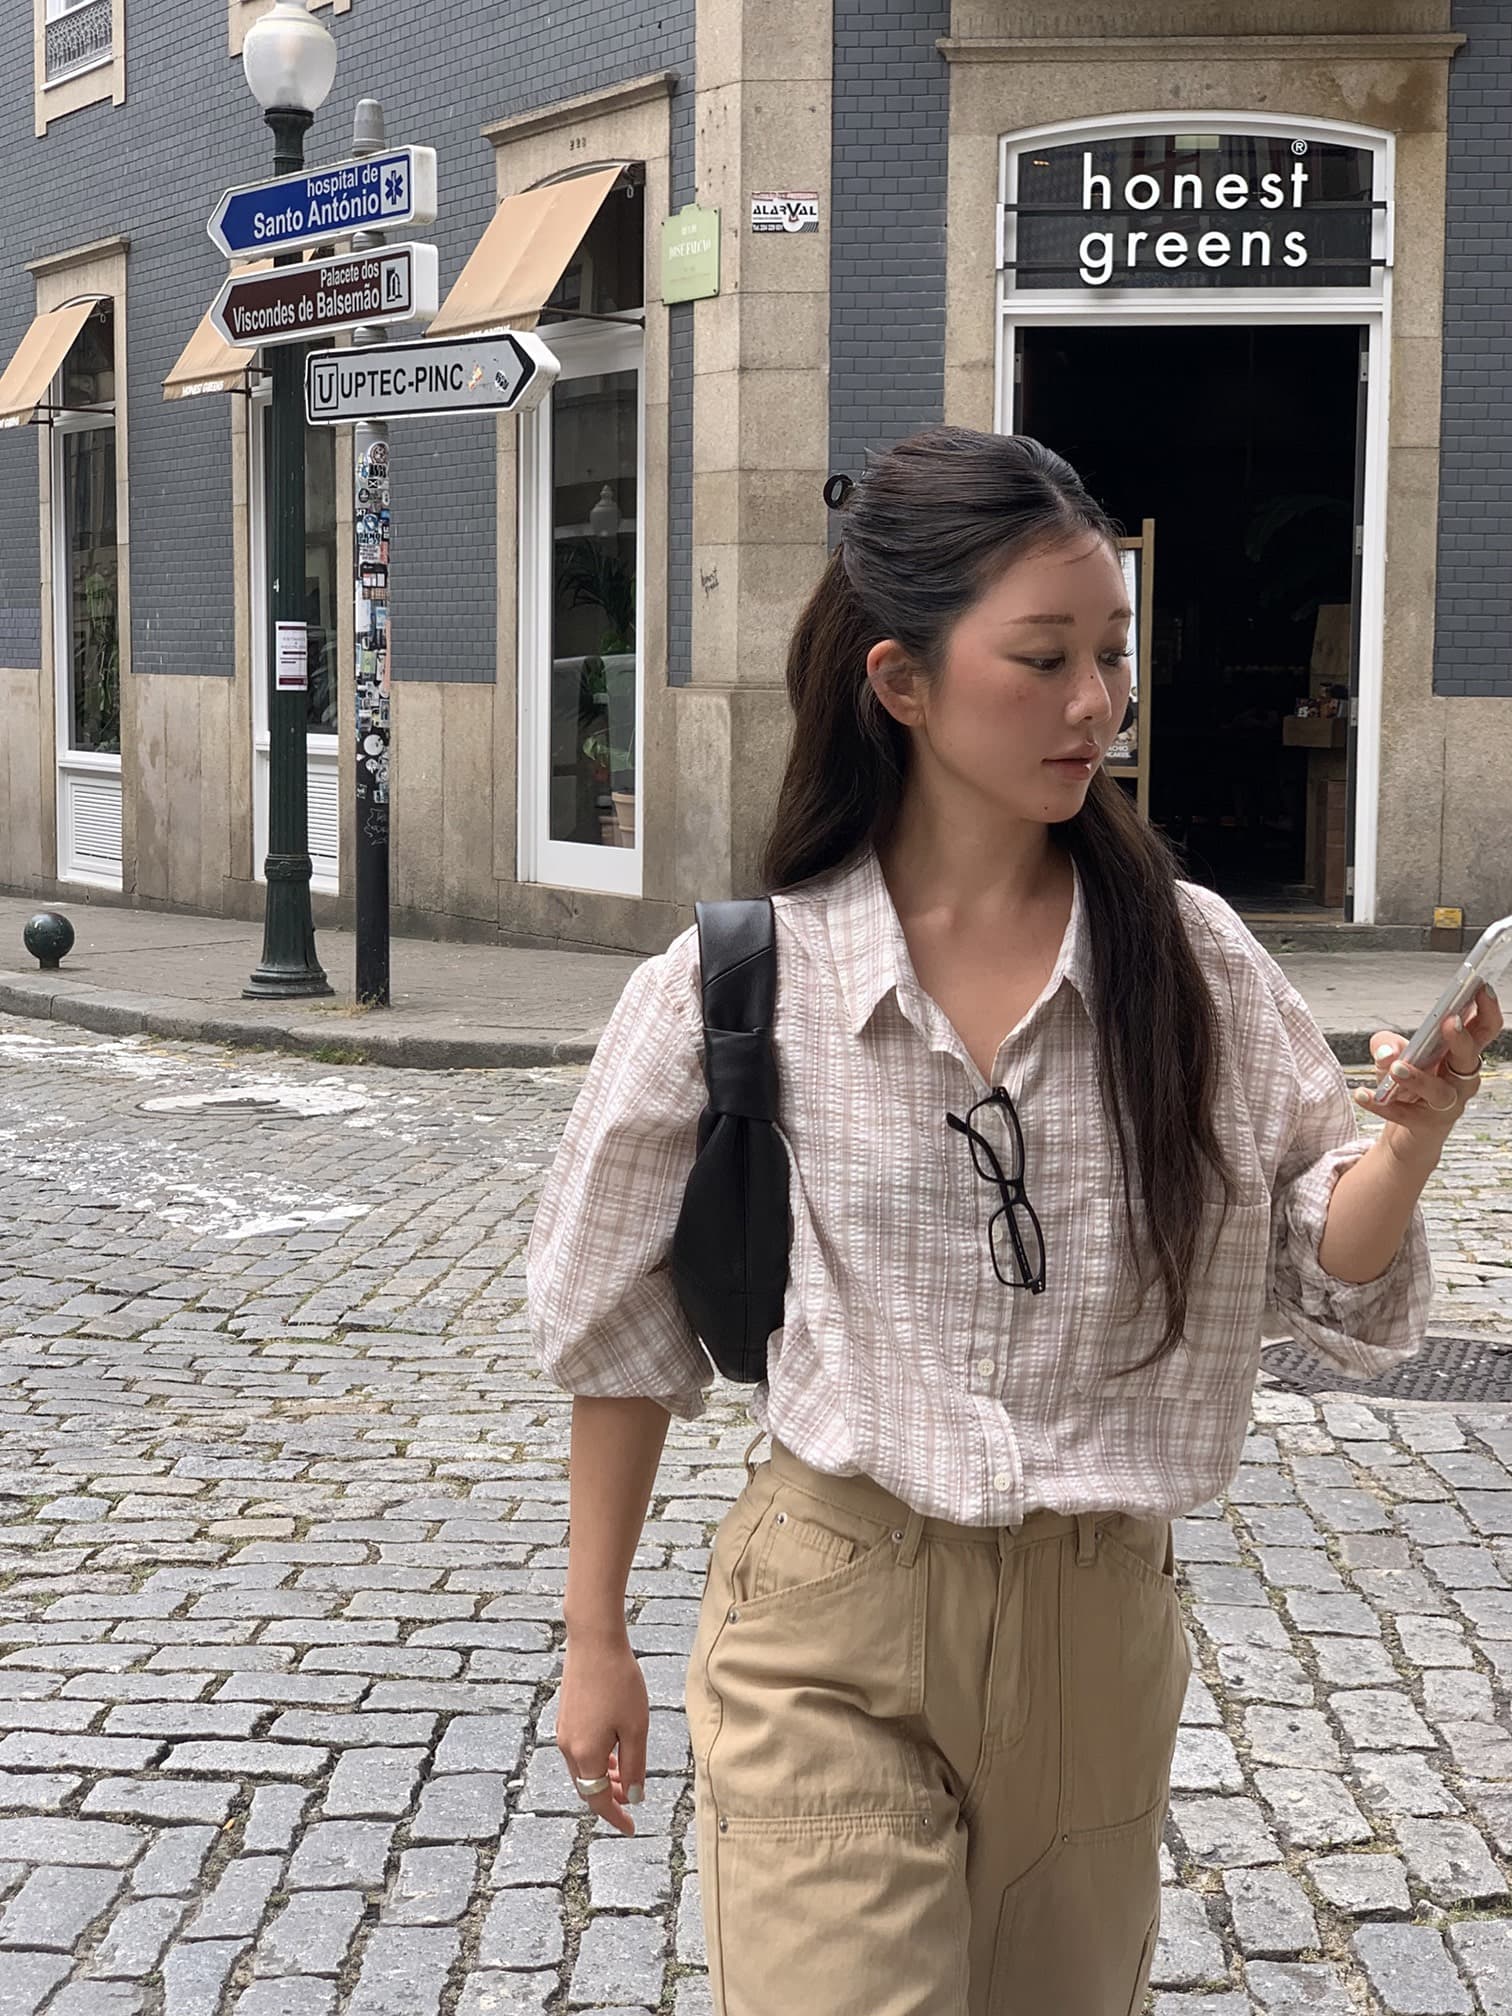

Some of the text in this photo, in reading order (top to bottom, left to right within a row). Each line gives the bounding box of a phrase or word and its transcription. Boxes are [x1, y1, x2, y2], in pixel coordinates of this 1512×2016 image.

[307, 164, 379, 198] hospital de
[1082, 152, 1309, 210] honest
[253, 189, 379, 239] Santo António
[753, 203, 817, 217] ALARVAL
[320, 260, 379, 288] Palacete dos
[1079, 230, 1308, 286] greens
[232, 282, 380, 333] Viscondes de Balsemão
[341, 363, 463, 398] UPTEC-PINC
